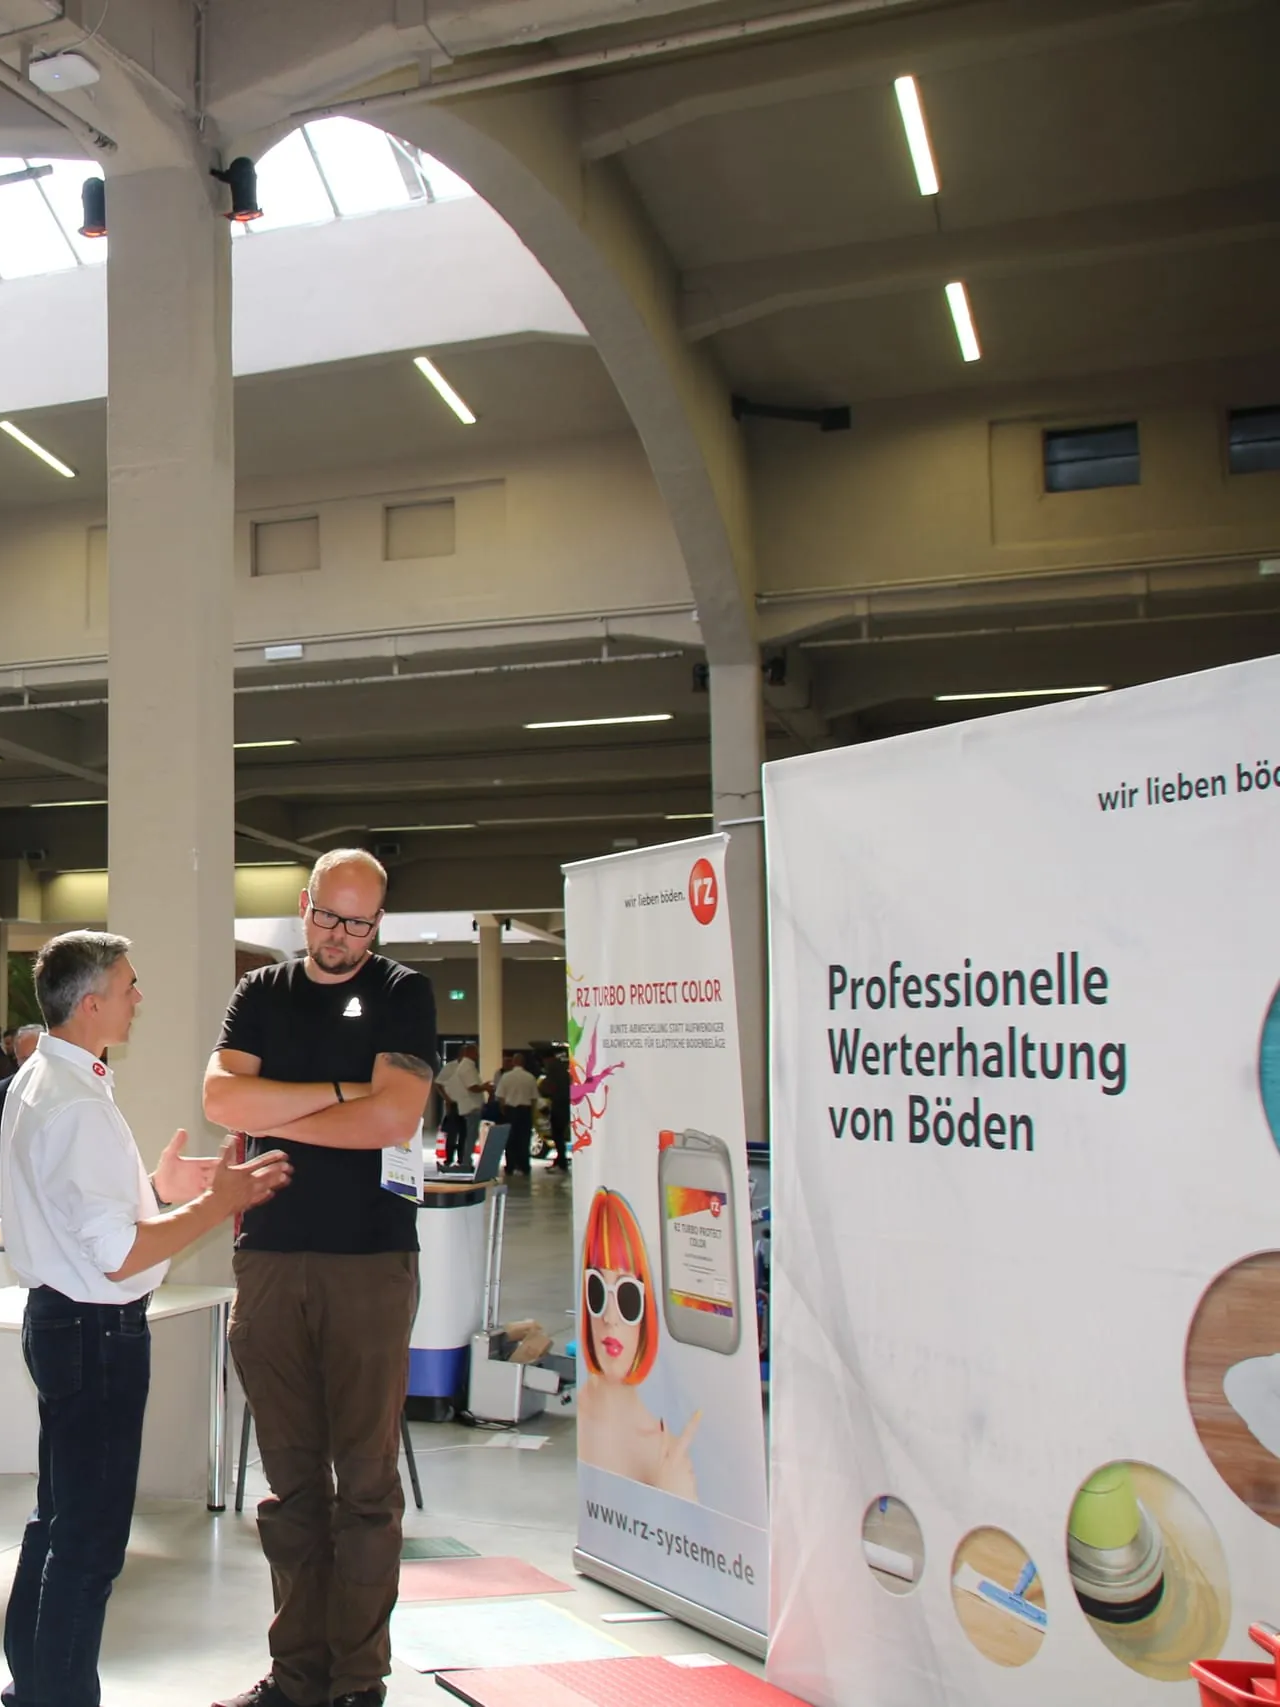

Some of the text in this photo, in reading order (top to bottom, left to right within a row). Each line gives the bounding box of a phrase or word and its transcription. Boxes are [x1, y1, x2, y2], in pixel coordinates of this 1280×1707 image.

[1098, 782, 1139, 811] wir
[1146, 772, 1226, 805] lieben
[638, 893, 659, 906] lieben
[576, 979, 722, 1007] RZ TURBO PROTECT COLOR
[828, 951, 1109, 1010] Professionelle
[827, 1026, 1127, 1096] Werterhaltung
[828, 1094, 1035, 1152] von Böden
[586, 1500, 756, 1585] www.rz-systeme.de
